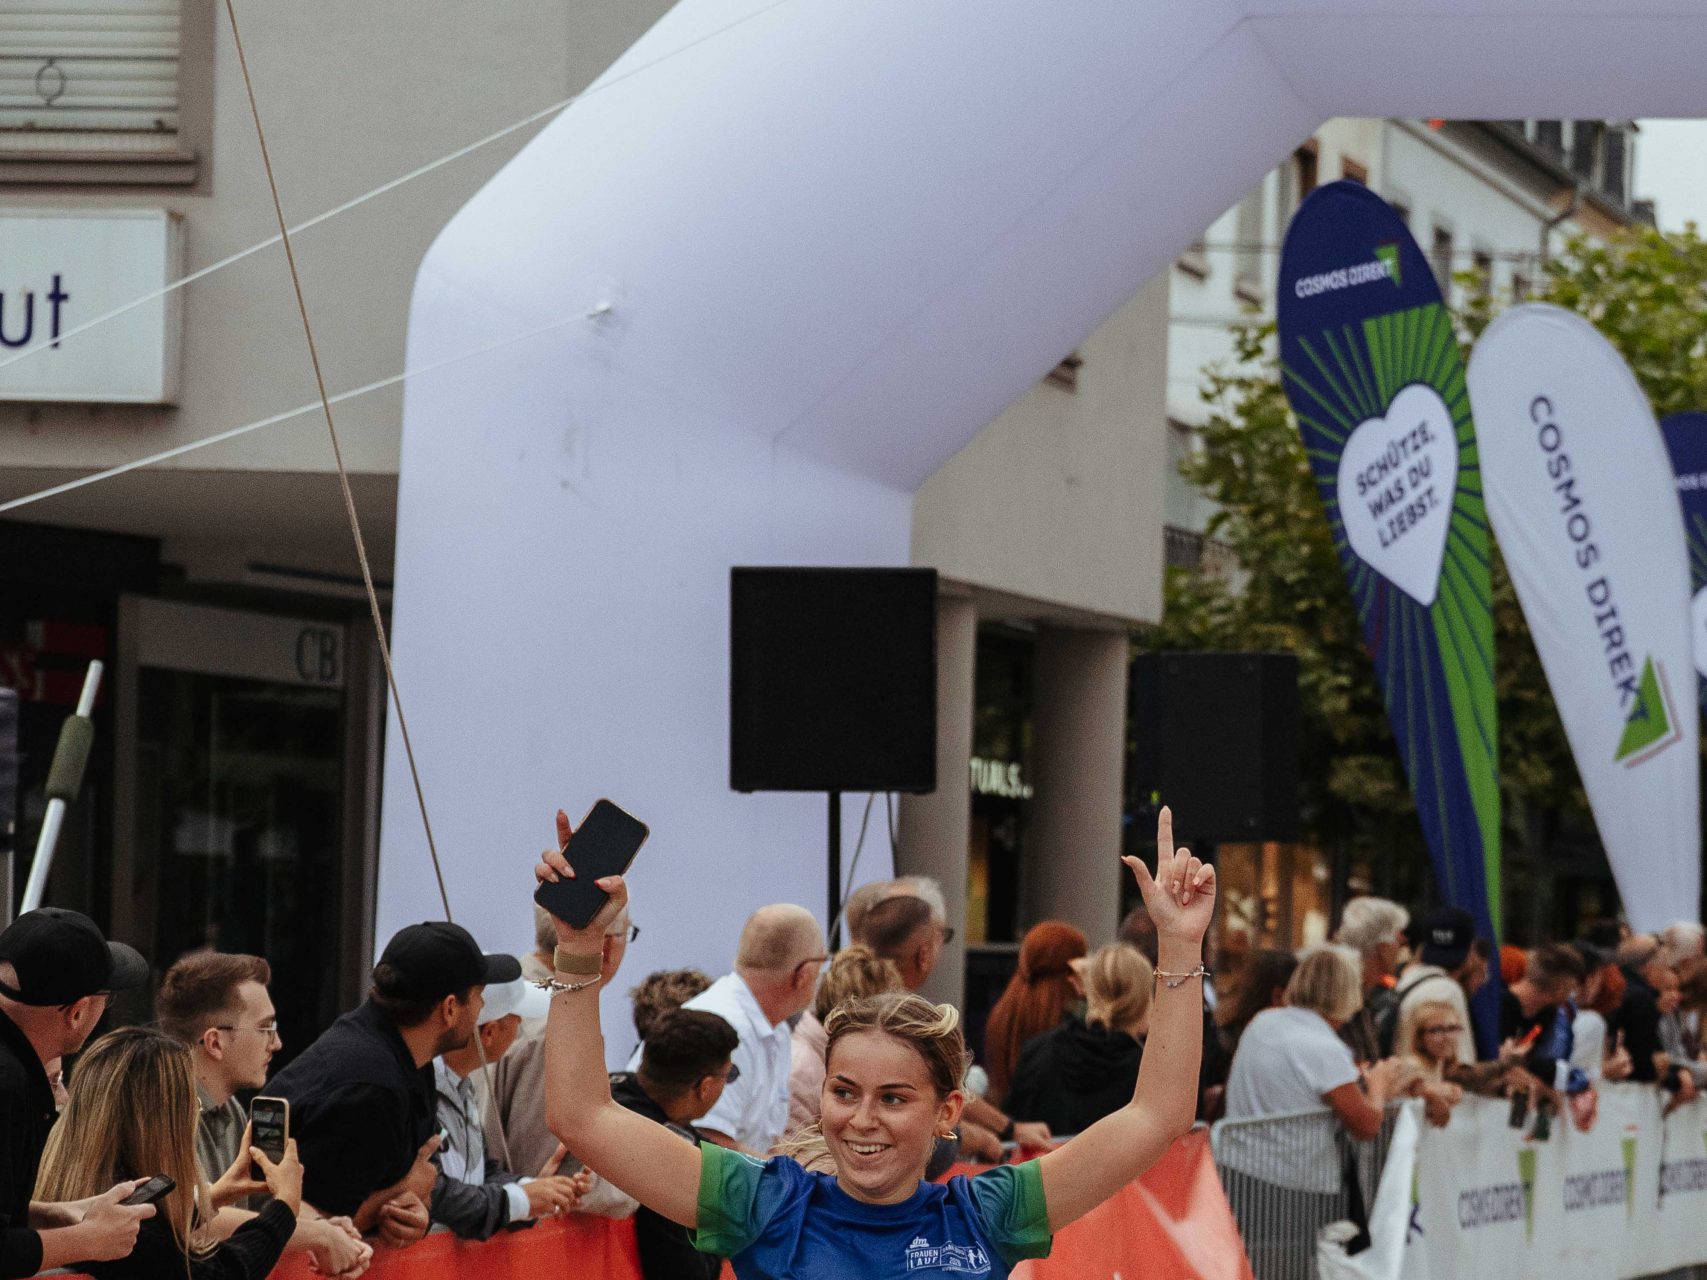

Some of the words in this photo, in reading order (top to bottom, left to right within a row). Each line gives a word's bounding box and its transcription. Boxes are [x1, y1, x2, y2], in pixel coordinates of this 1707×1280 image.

[1295, 267, 1349, 298] COSMOS
[1348, 258, 1392, 286] DIREKT
[0, 274, 69, 350] ut
[1367, 478, 1405, 520] WAS
[1407, 455, 1432, 490] DU
[1529, 394, 1600, 571] COSMOS
[1586, 574, 1652, 724] DIREKT
[910, 1249, 939, 1259] FRAUEN
[910, 1256, 938, 1269] LAUF
